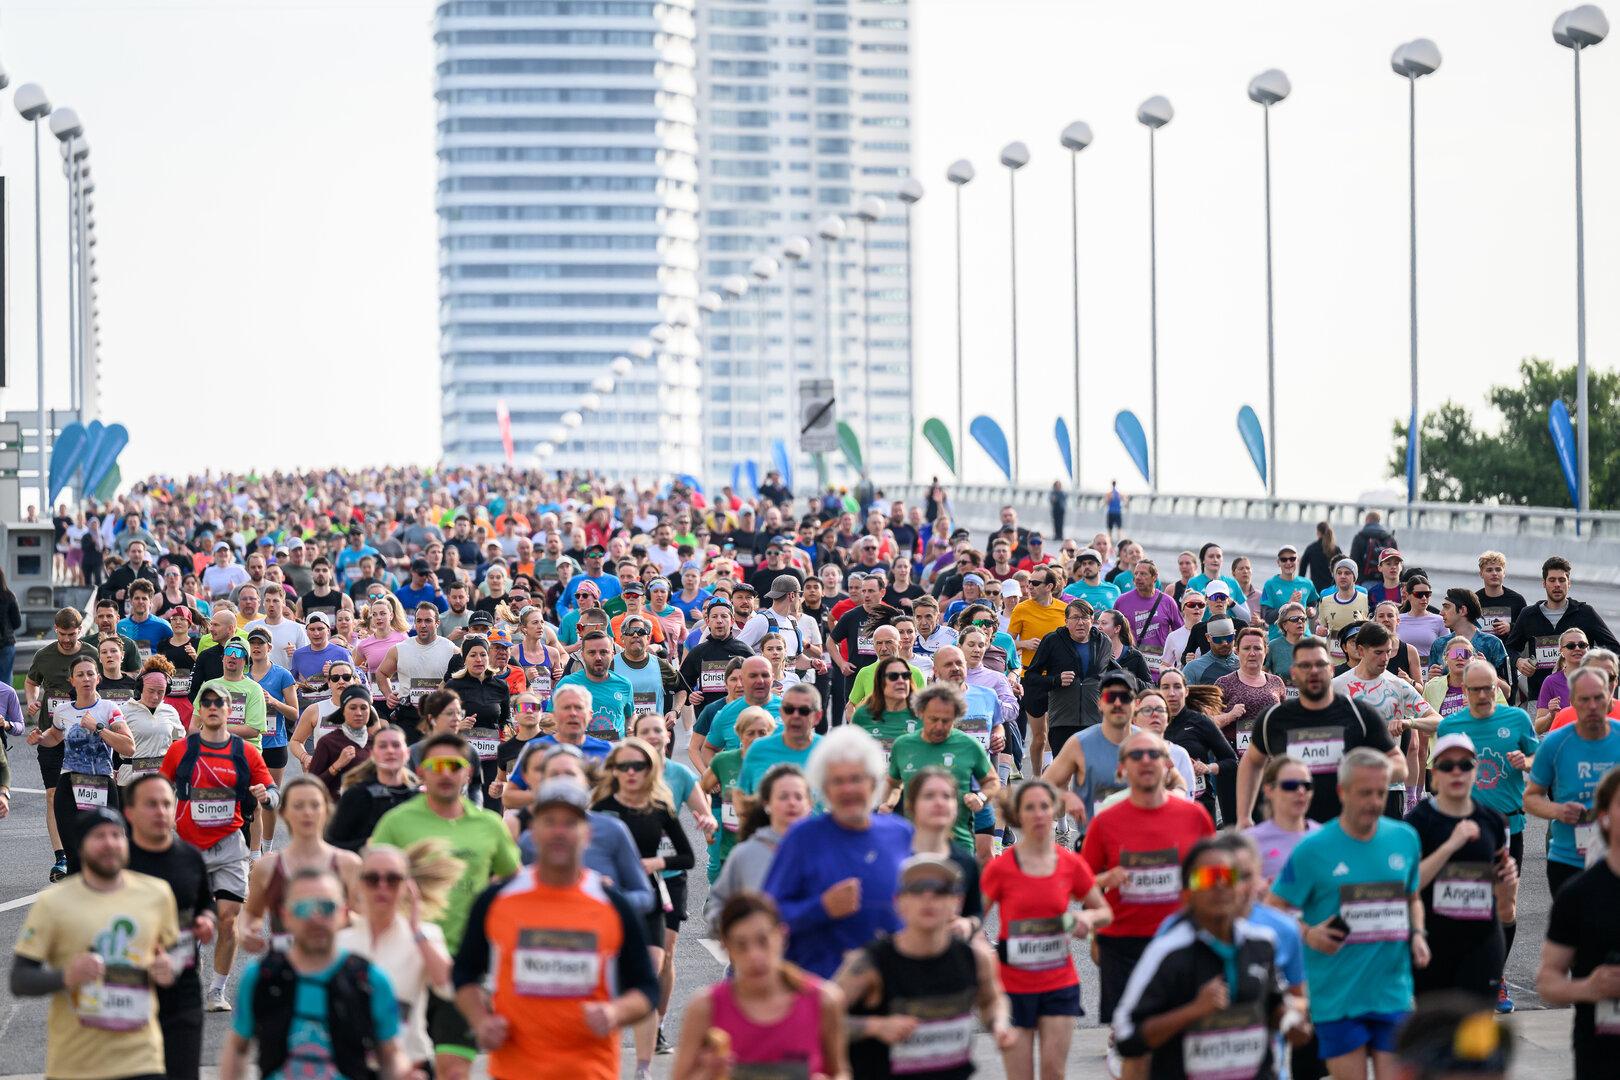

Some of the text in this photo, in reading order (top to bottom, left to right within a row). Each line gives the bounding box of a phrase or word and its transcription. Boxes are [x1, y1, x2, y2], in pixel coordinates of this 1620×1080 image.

[703, 673, 724, 682] Christ
[1302, 745, 1329, 757] Anel
[77, 788, 98, 799] Maja
[198, 803, 228, 813] Simon
[1130, 872, 1171, 885] Fabian
[1443, 886, 1485, 901] Angela
[1019, 940, 1060, 953] Miriam
